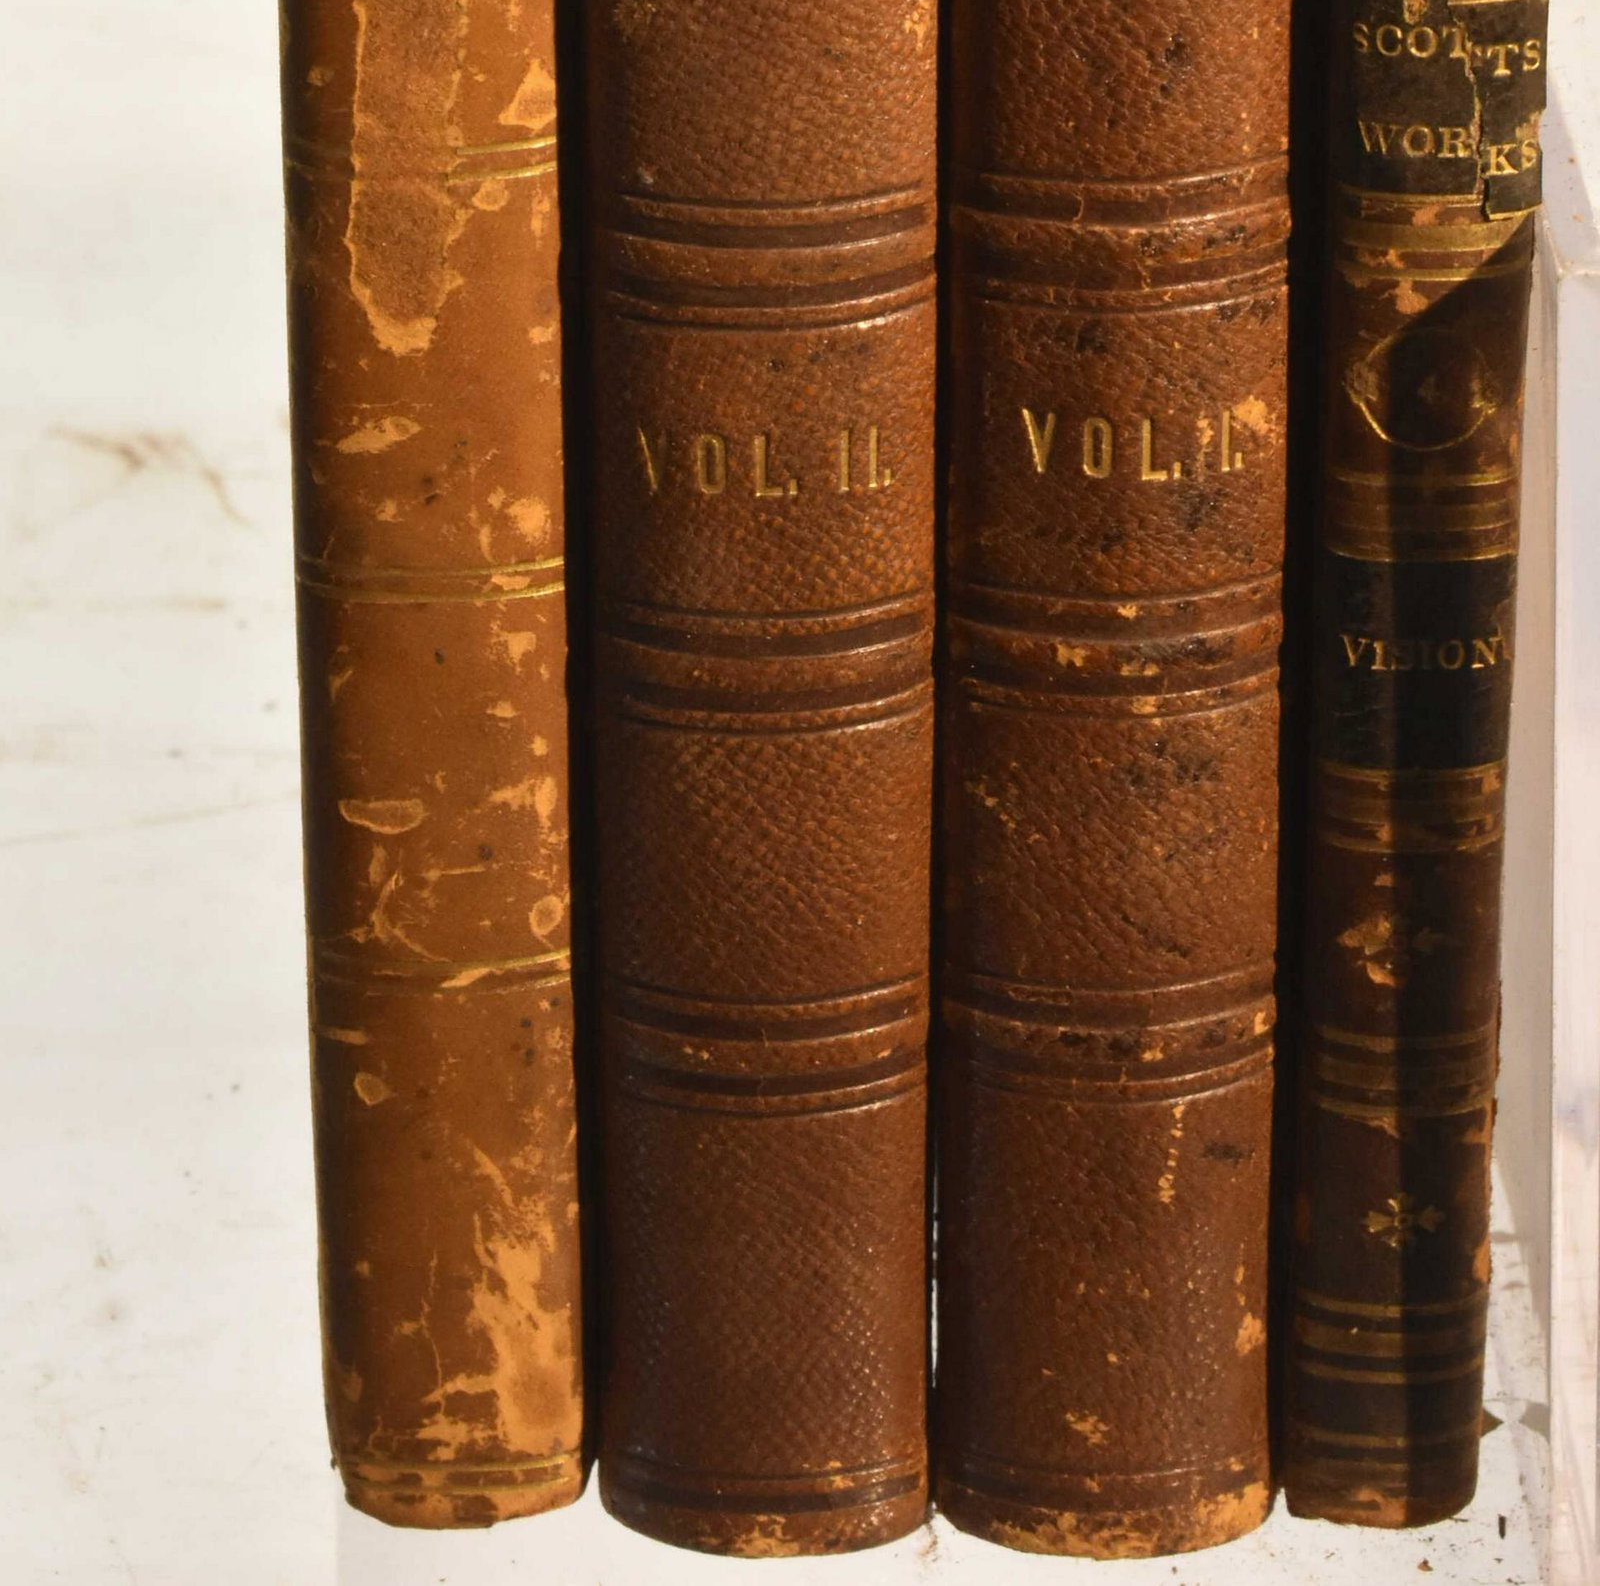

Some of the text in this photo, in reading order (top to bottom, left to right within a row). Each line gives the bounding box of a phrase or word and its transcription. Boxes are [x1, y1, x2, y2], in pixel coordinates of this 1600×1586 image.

[1357, 120, 1540, 176] WORKS
[637, 426, 798, 497] VOL.
[1022, 408, 1182, 481] VOL.
[1339, 634, 1503, 671] VISION
